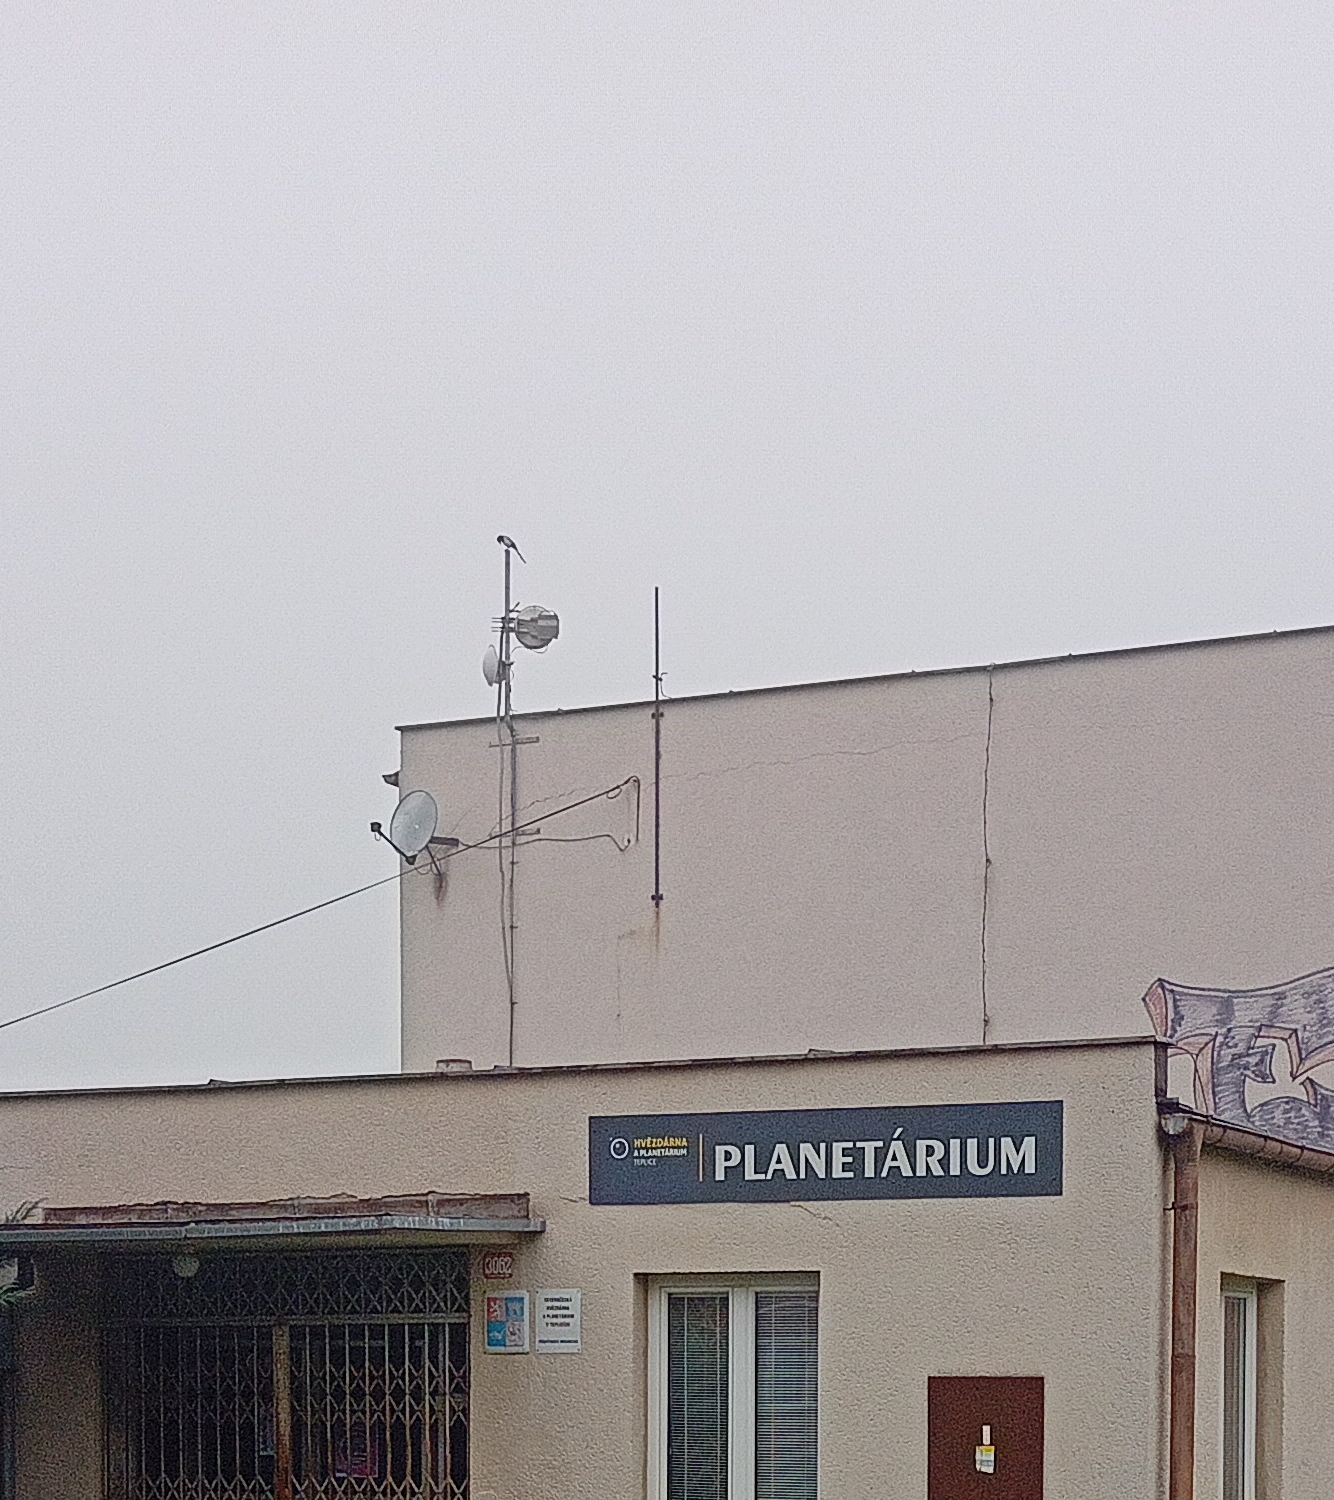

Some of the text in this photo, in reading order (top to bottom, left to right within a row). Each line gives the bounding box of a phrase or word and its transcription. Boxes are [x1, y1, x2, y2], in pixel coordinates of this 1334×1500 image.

[634, 1136, 688, 1148] HVĚZDÁRNA
[633, 1148, 687, 1157] A PLANETÁRIUM
[714, 1127, 1037, 1181] PLANETÁRIUM
[485, 1257, 512, 1274] 3062
